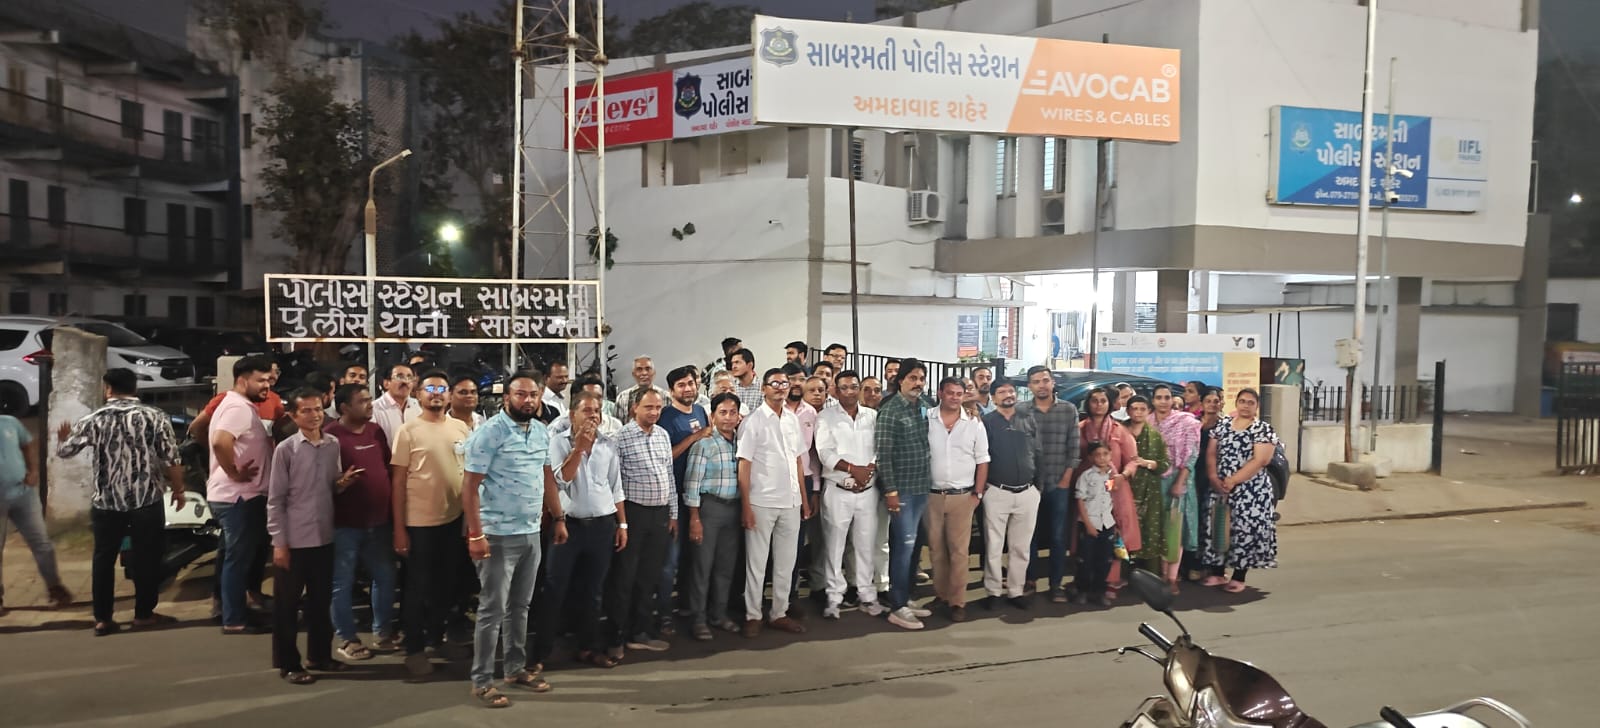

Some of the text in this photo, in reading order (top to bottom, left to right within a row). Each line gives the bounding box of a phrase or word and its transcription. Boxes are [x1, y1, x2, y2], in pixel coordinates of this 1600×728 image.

[806, 37, 1019, 80] સાબરમતી પોલીસ સ્ટેશન
[702, 90, 749, 118] પોલીસ
[853, 94, 988, 122] અમદાવાદ શહેર
[1040, 107, 1171, 128] WIRES & CABLES
[1459, 139, 1481, 154] IIFL
[278, 279, 588, 310] પોલીસ સ્ટેશન સાબરમતી
[379, 311, 451, 337] थाना
[480, 309, 590, 337] साबरमती
